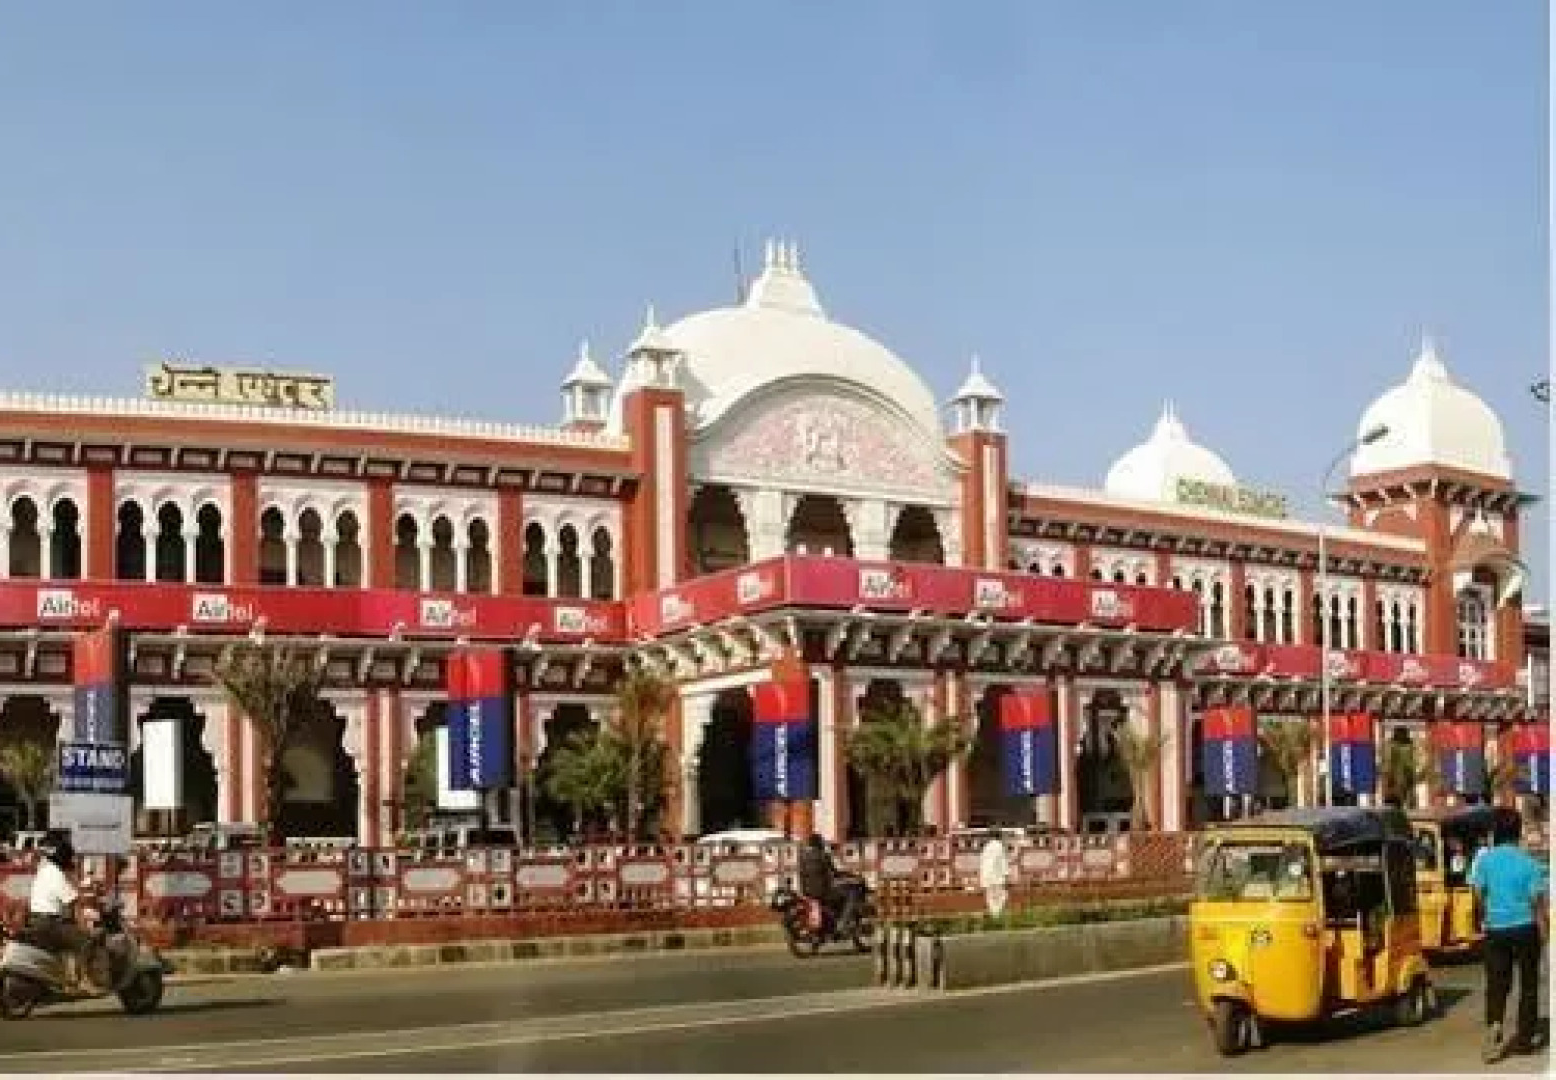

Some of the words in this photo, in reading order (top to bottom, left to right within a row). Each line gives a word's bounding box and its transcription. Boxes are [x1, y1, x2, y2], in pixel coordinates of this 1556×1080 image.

[42, 595, 101, 617] Airtel
[197, 599, 253, 621] Airtel
[62, 747, 125, 770] STAND
